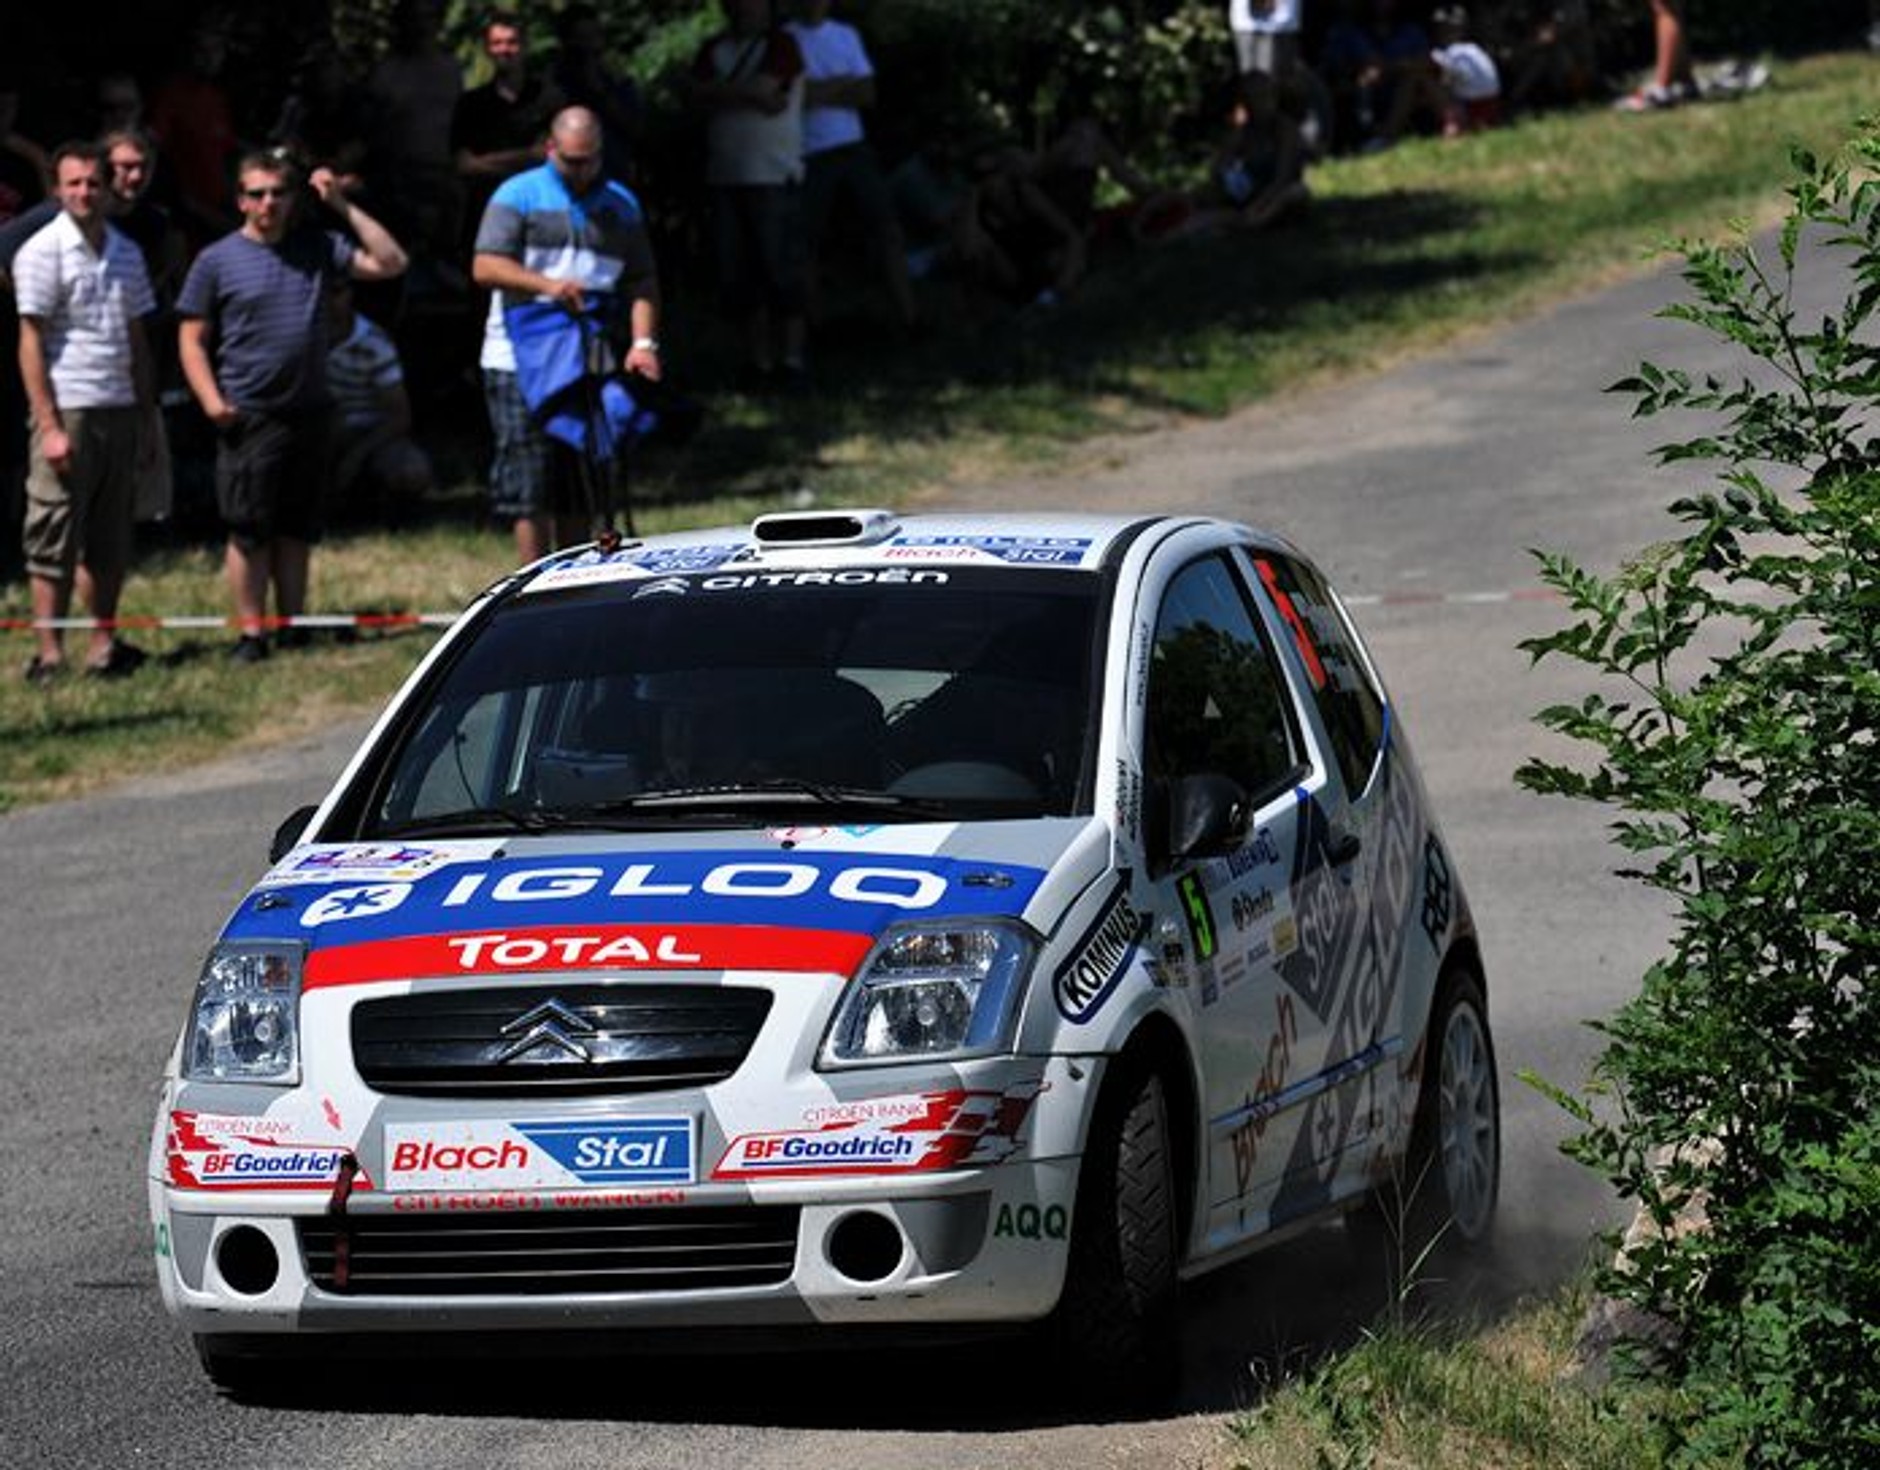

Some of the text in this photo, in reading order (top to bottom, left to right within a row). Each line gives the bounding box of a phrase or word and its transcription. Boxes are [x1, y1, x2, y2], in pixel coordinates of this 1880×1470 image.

[1002, 549, 1065, 561] Stal
[701, 568, 950, 591] CITROËN
[1182, 874, 1212, 960] 5
[448, 934, 703, 969] TOTAL
[1061, 896, 1141, 1011] KOMINUS
[876, 1101, 926, 1118] BANK
[392, 1134, 668, 1172] Blach Stal
[743, 1133, 914, 1160] BFGoodrich
[993, 1203, 1068, 1241] AQQ
